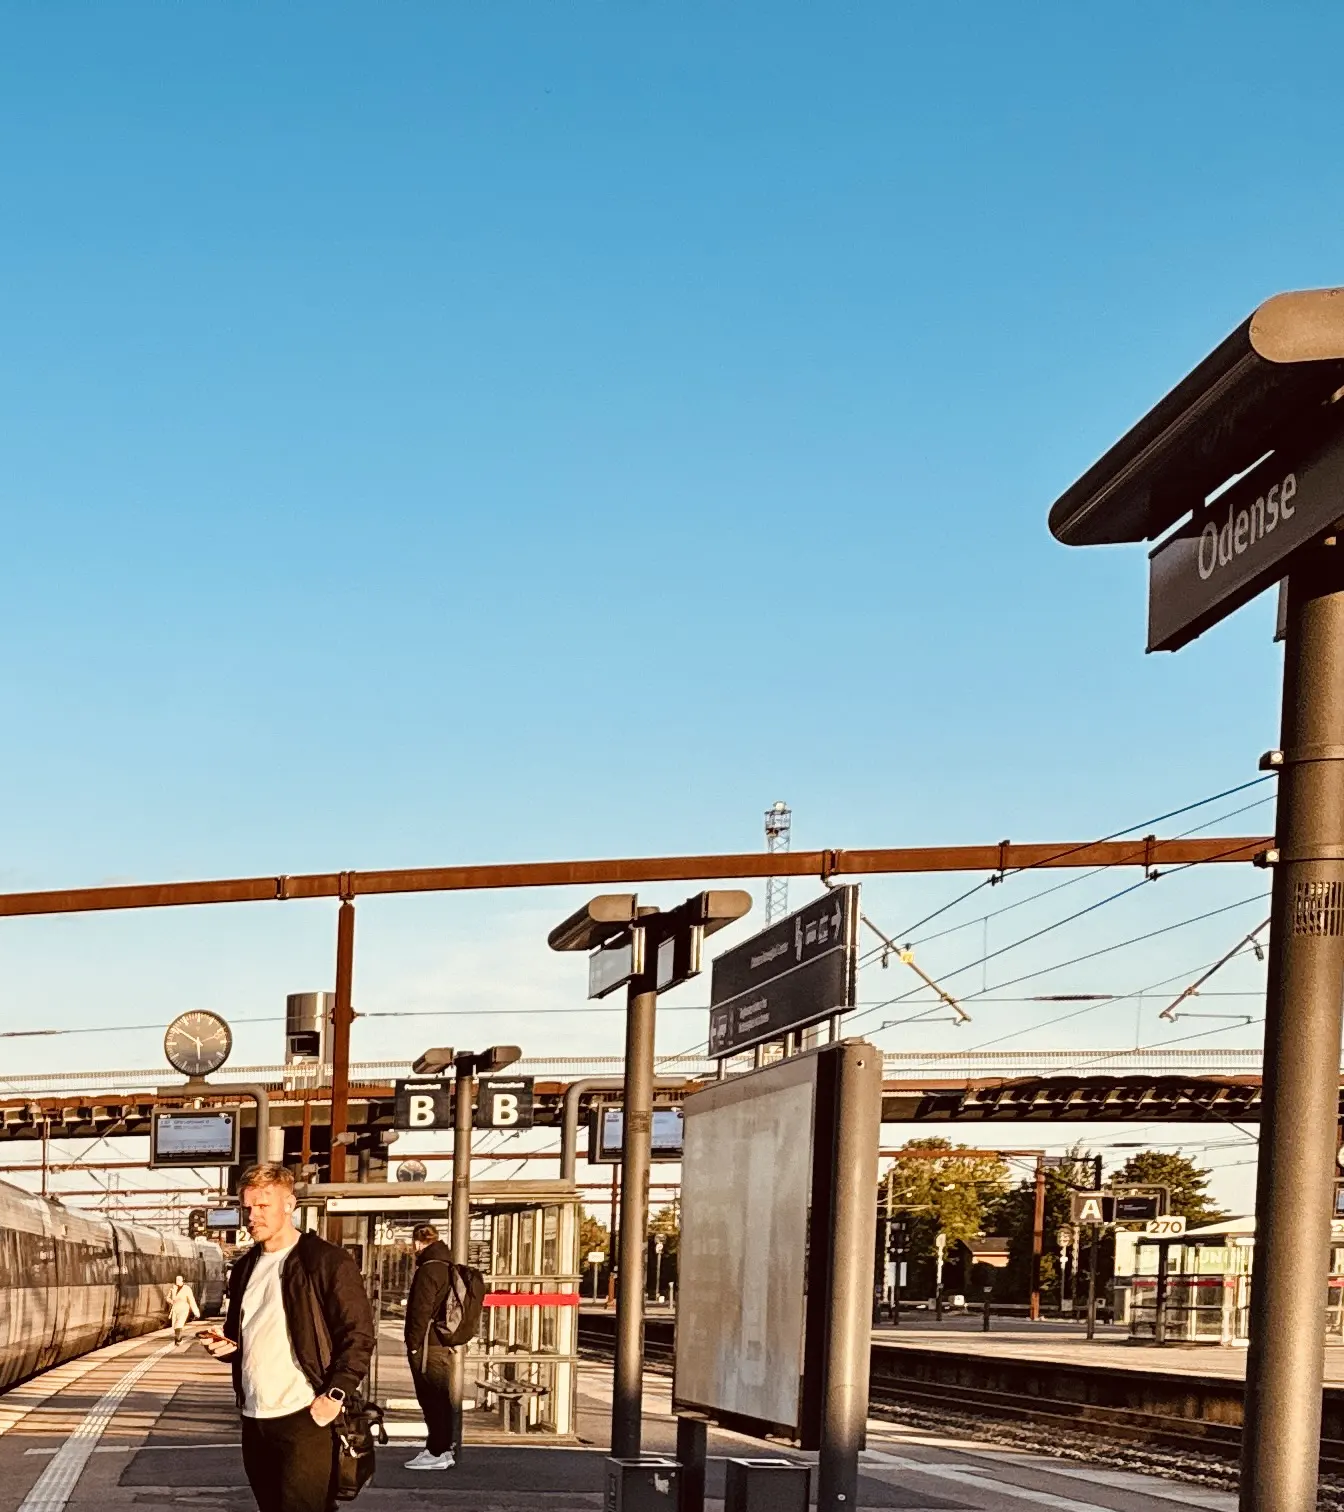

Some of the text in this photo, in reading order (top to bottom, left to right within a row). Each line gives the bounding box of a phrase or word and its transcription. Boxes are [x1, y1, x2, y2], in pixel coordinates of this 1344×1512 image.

[1198, 473, 1297, 580] Odense
[409, 1095, 435, 1127] B
[493, 1094, 519, 1126] B
[1079, 1200, 1102, 1220] A
[1149, 1221, 1182, 1234] 270
